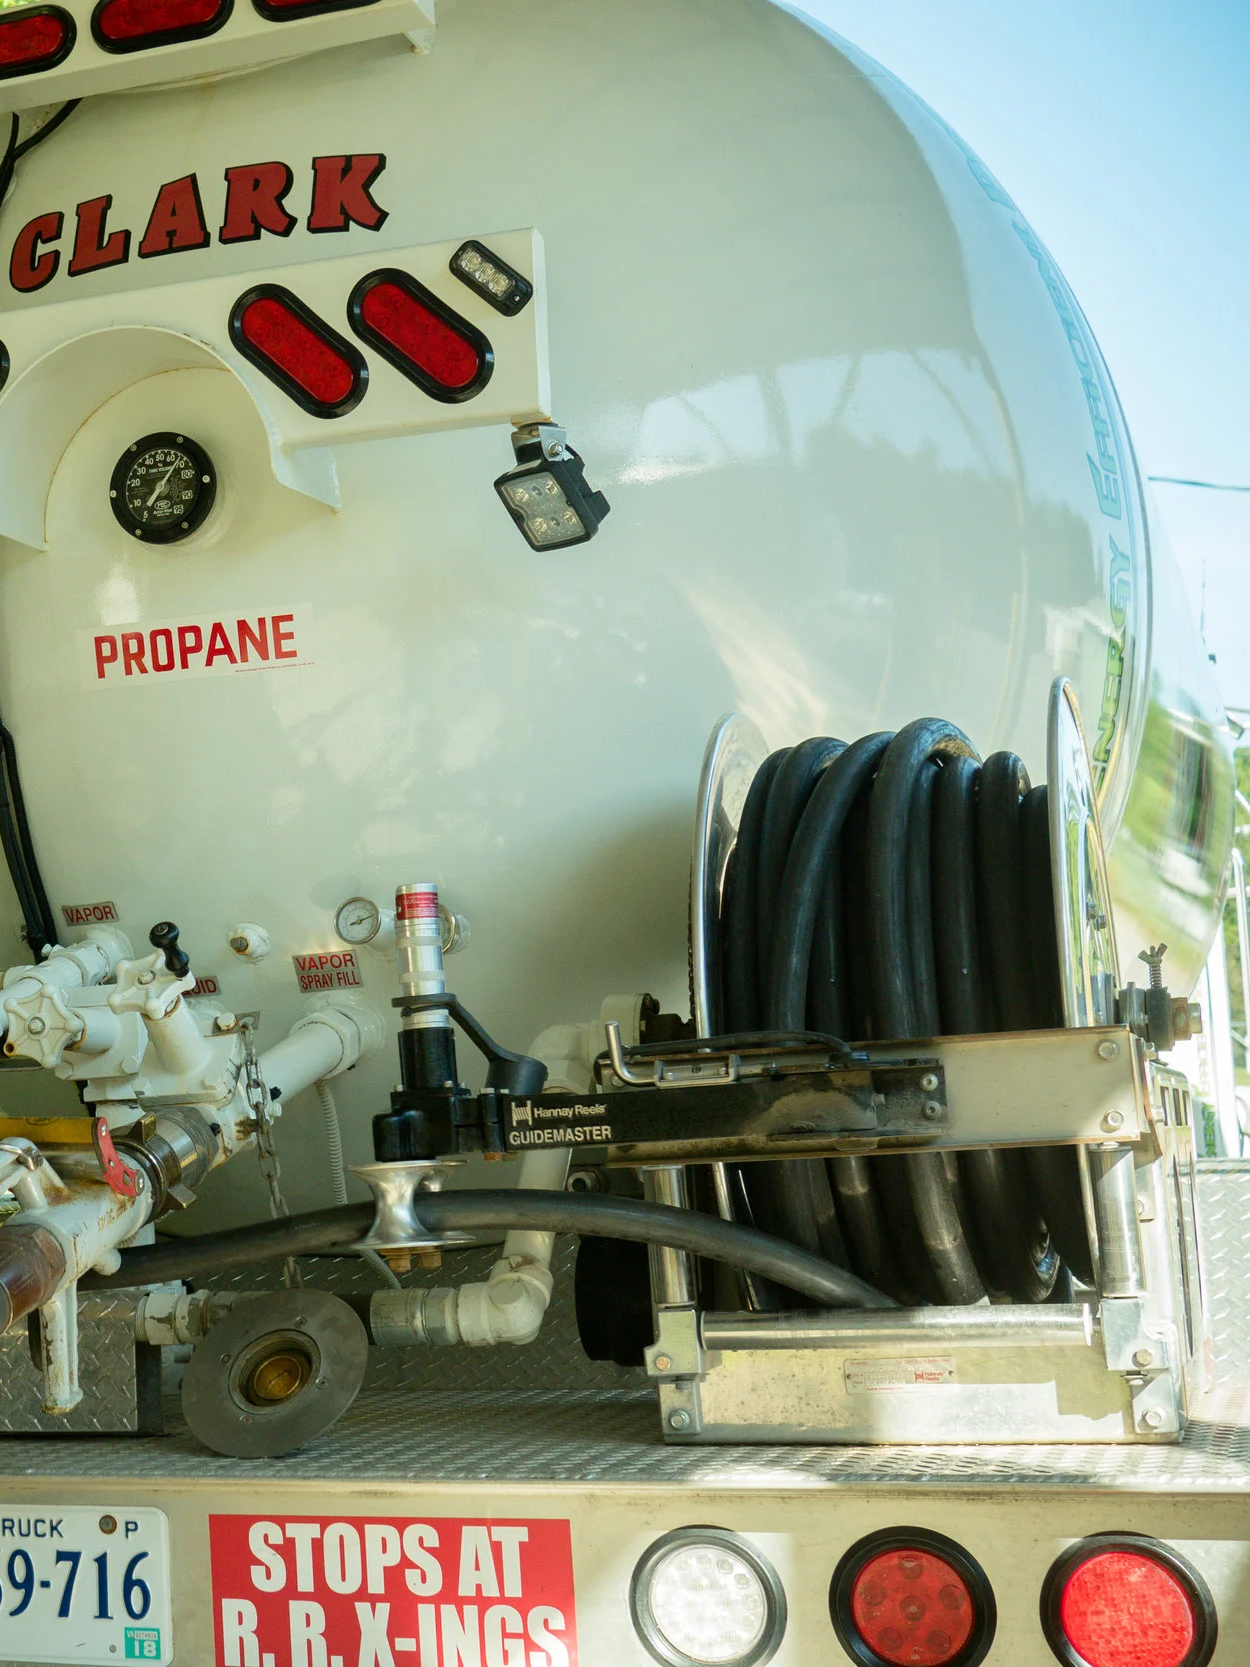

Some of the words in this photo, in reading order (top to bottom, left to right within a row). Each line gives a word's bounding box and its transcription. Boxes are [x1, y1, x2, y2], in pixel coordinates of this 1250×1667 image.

[9, 153, 390, 293] CLARK
[166, 454, 176, 462] 60
[94, 614, 298, 679] PROPANE
[64, 905, 115, 923] VAPOR
[296, 953, 355, 971] VAPOR
[300, 972, 335, 990] SPRAY
[337, 971, 360, 987] FILL
[534, 1106, 574, 1118] Hannay
[575, 1104, 606, 1115] Reels
[509, 1126, 612, 1145] GUIDEMASTER
[124, 1521, 139, 1539] P
[248, 1521, 443, 1597] STOPS
[458, 1525, 529, 1598] AT
[355, 1601, 569, 1667] X-INGS
[134, 1640, 157, 1657] 18
